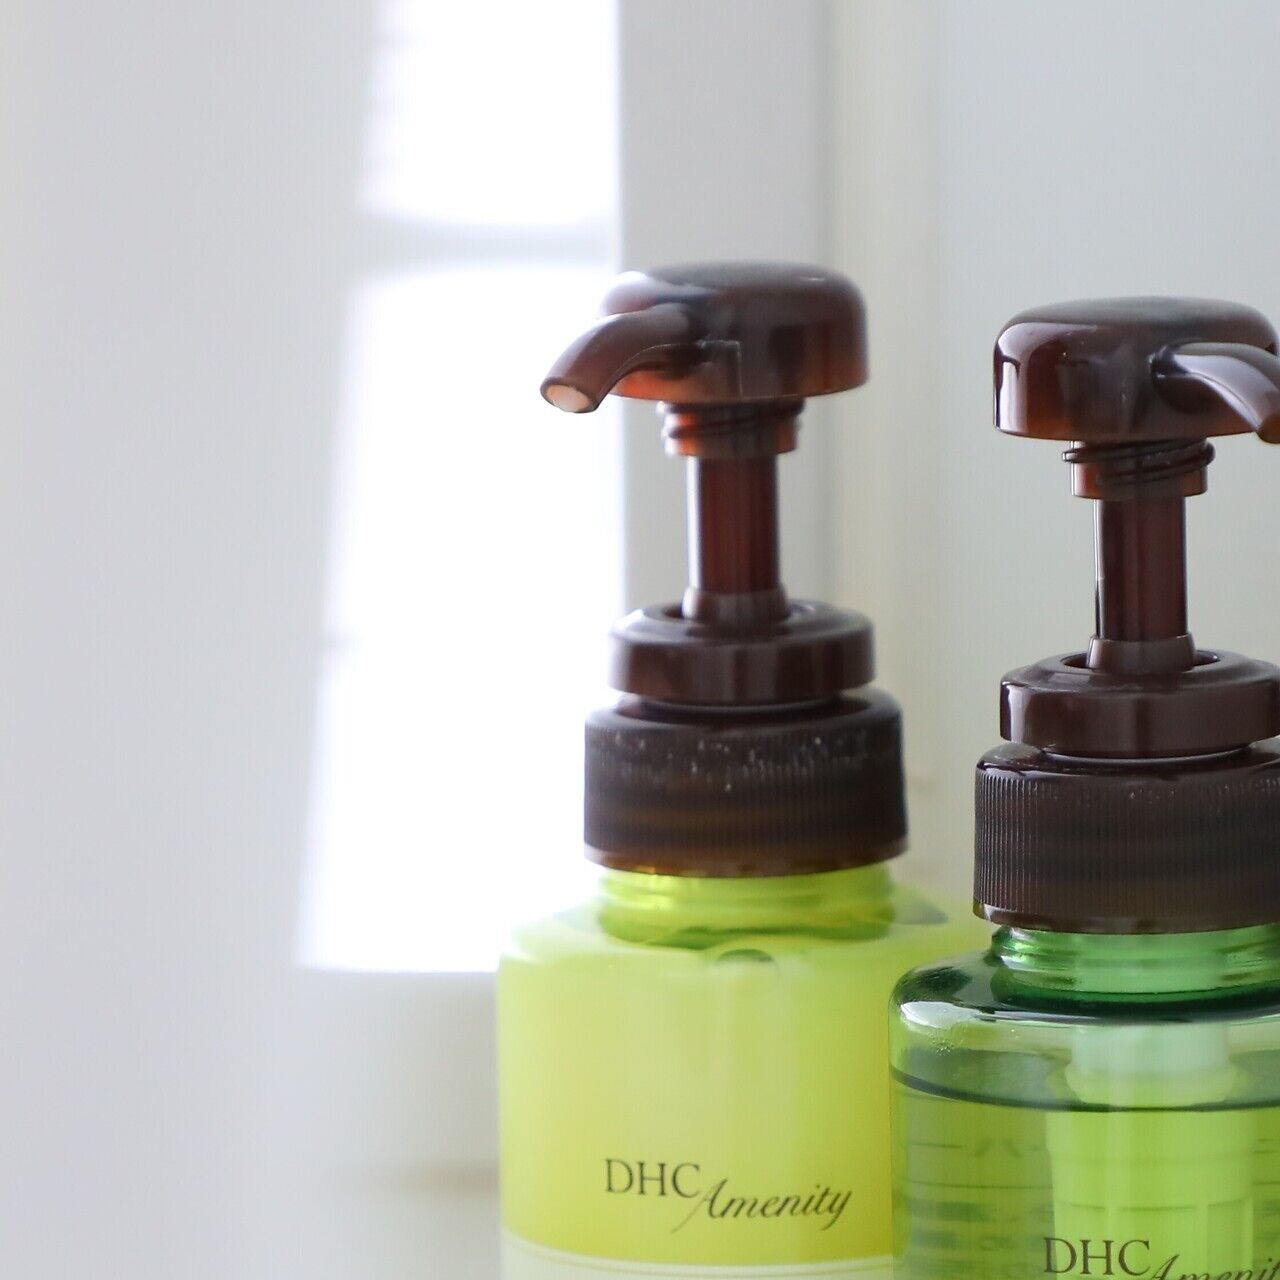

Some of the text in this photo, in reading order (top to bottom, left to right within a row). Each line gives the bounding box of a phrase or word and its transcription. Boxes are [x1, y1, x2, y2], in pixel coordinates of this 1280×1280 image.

[604, 1158, 853, 1234] DHC Amenity
[1043, 1236, 1151, 1277] DHC
